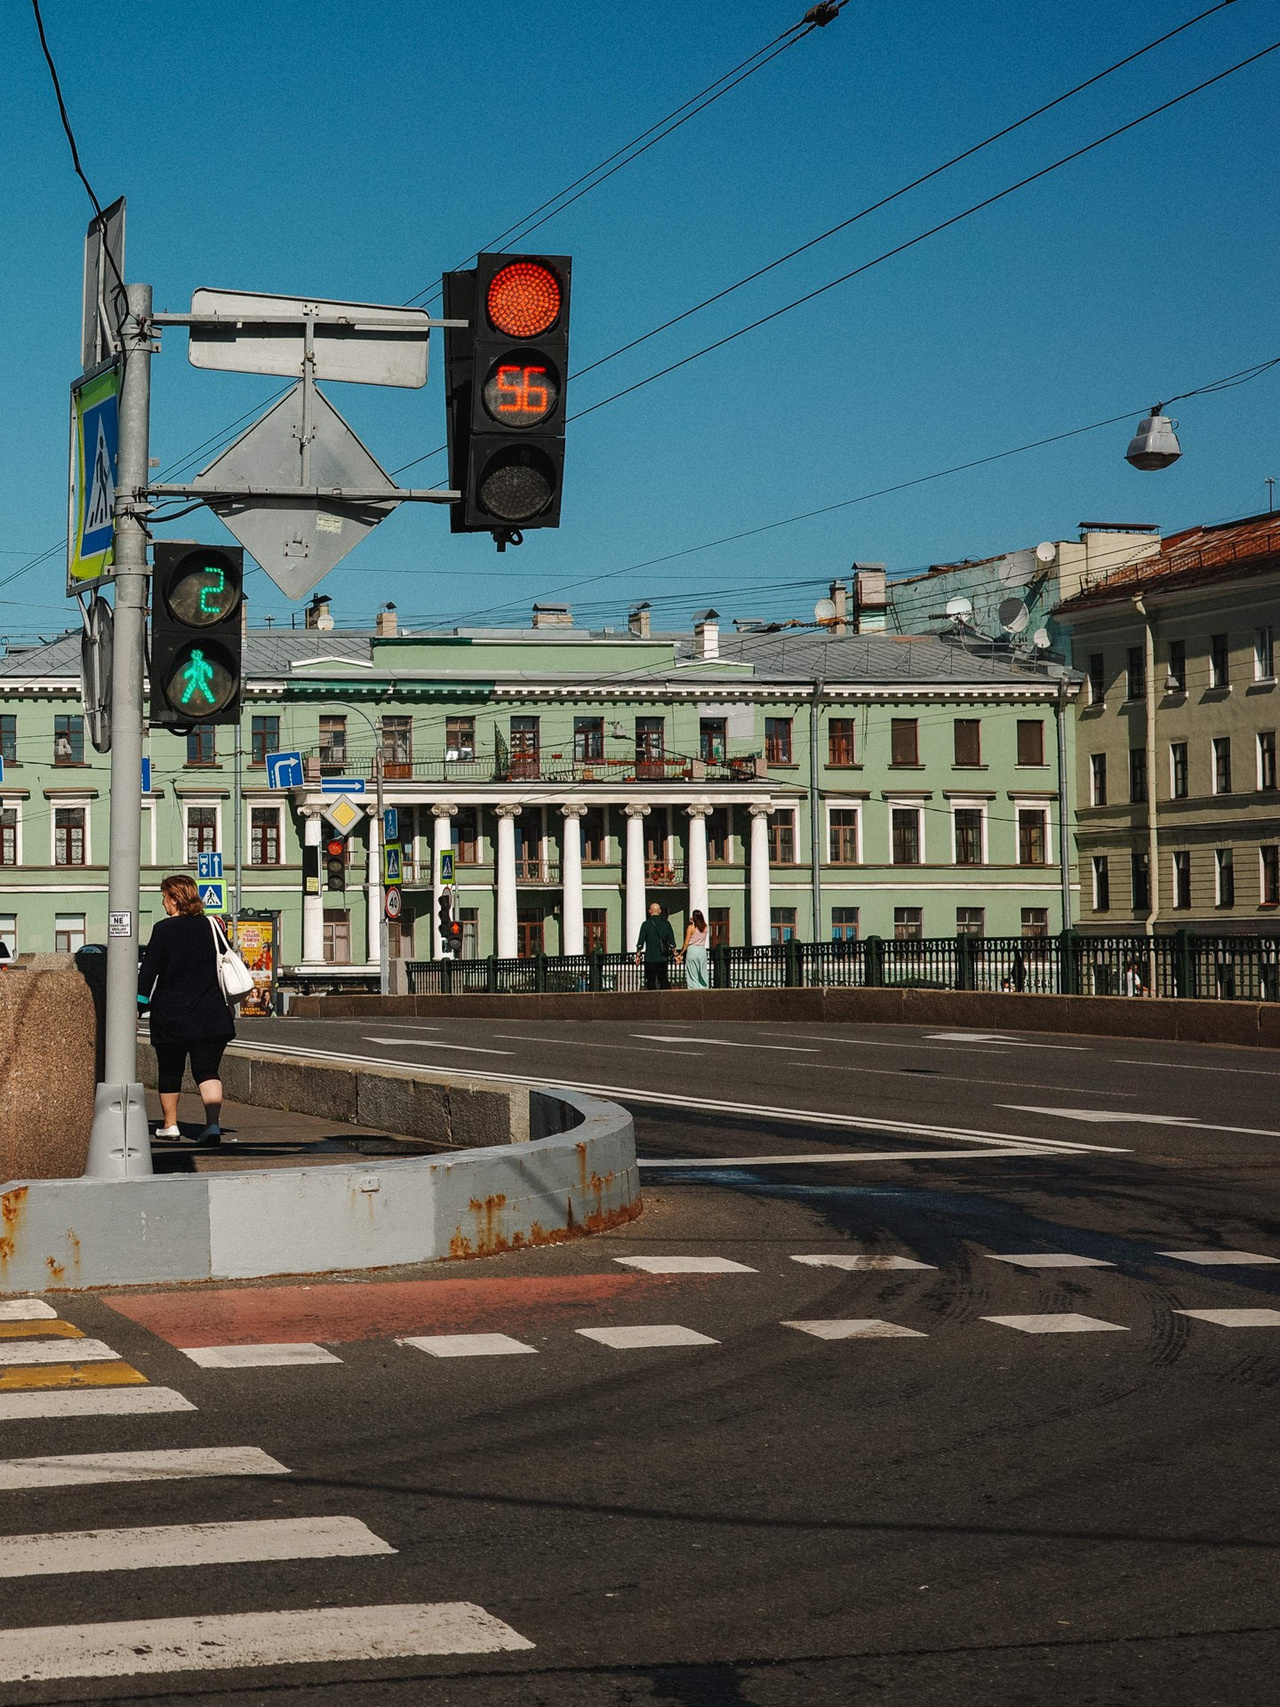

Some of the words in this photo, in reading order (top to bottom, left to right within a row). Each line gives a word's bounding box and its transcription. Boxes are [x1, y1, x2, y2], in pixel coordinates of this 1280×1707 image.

[497, 365, 548, 412] 56
[200, 567, 224, 613] 2
[389, 896, 397, 908] 40
